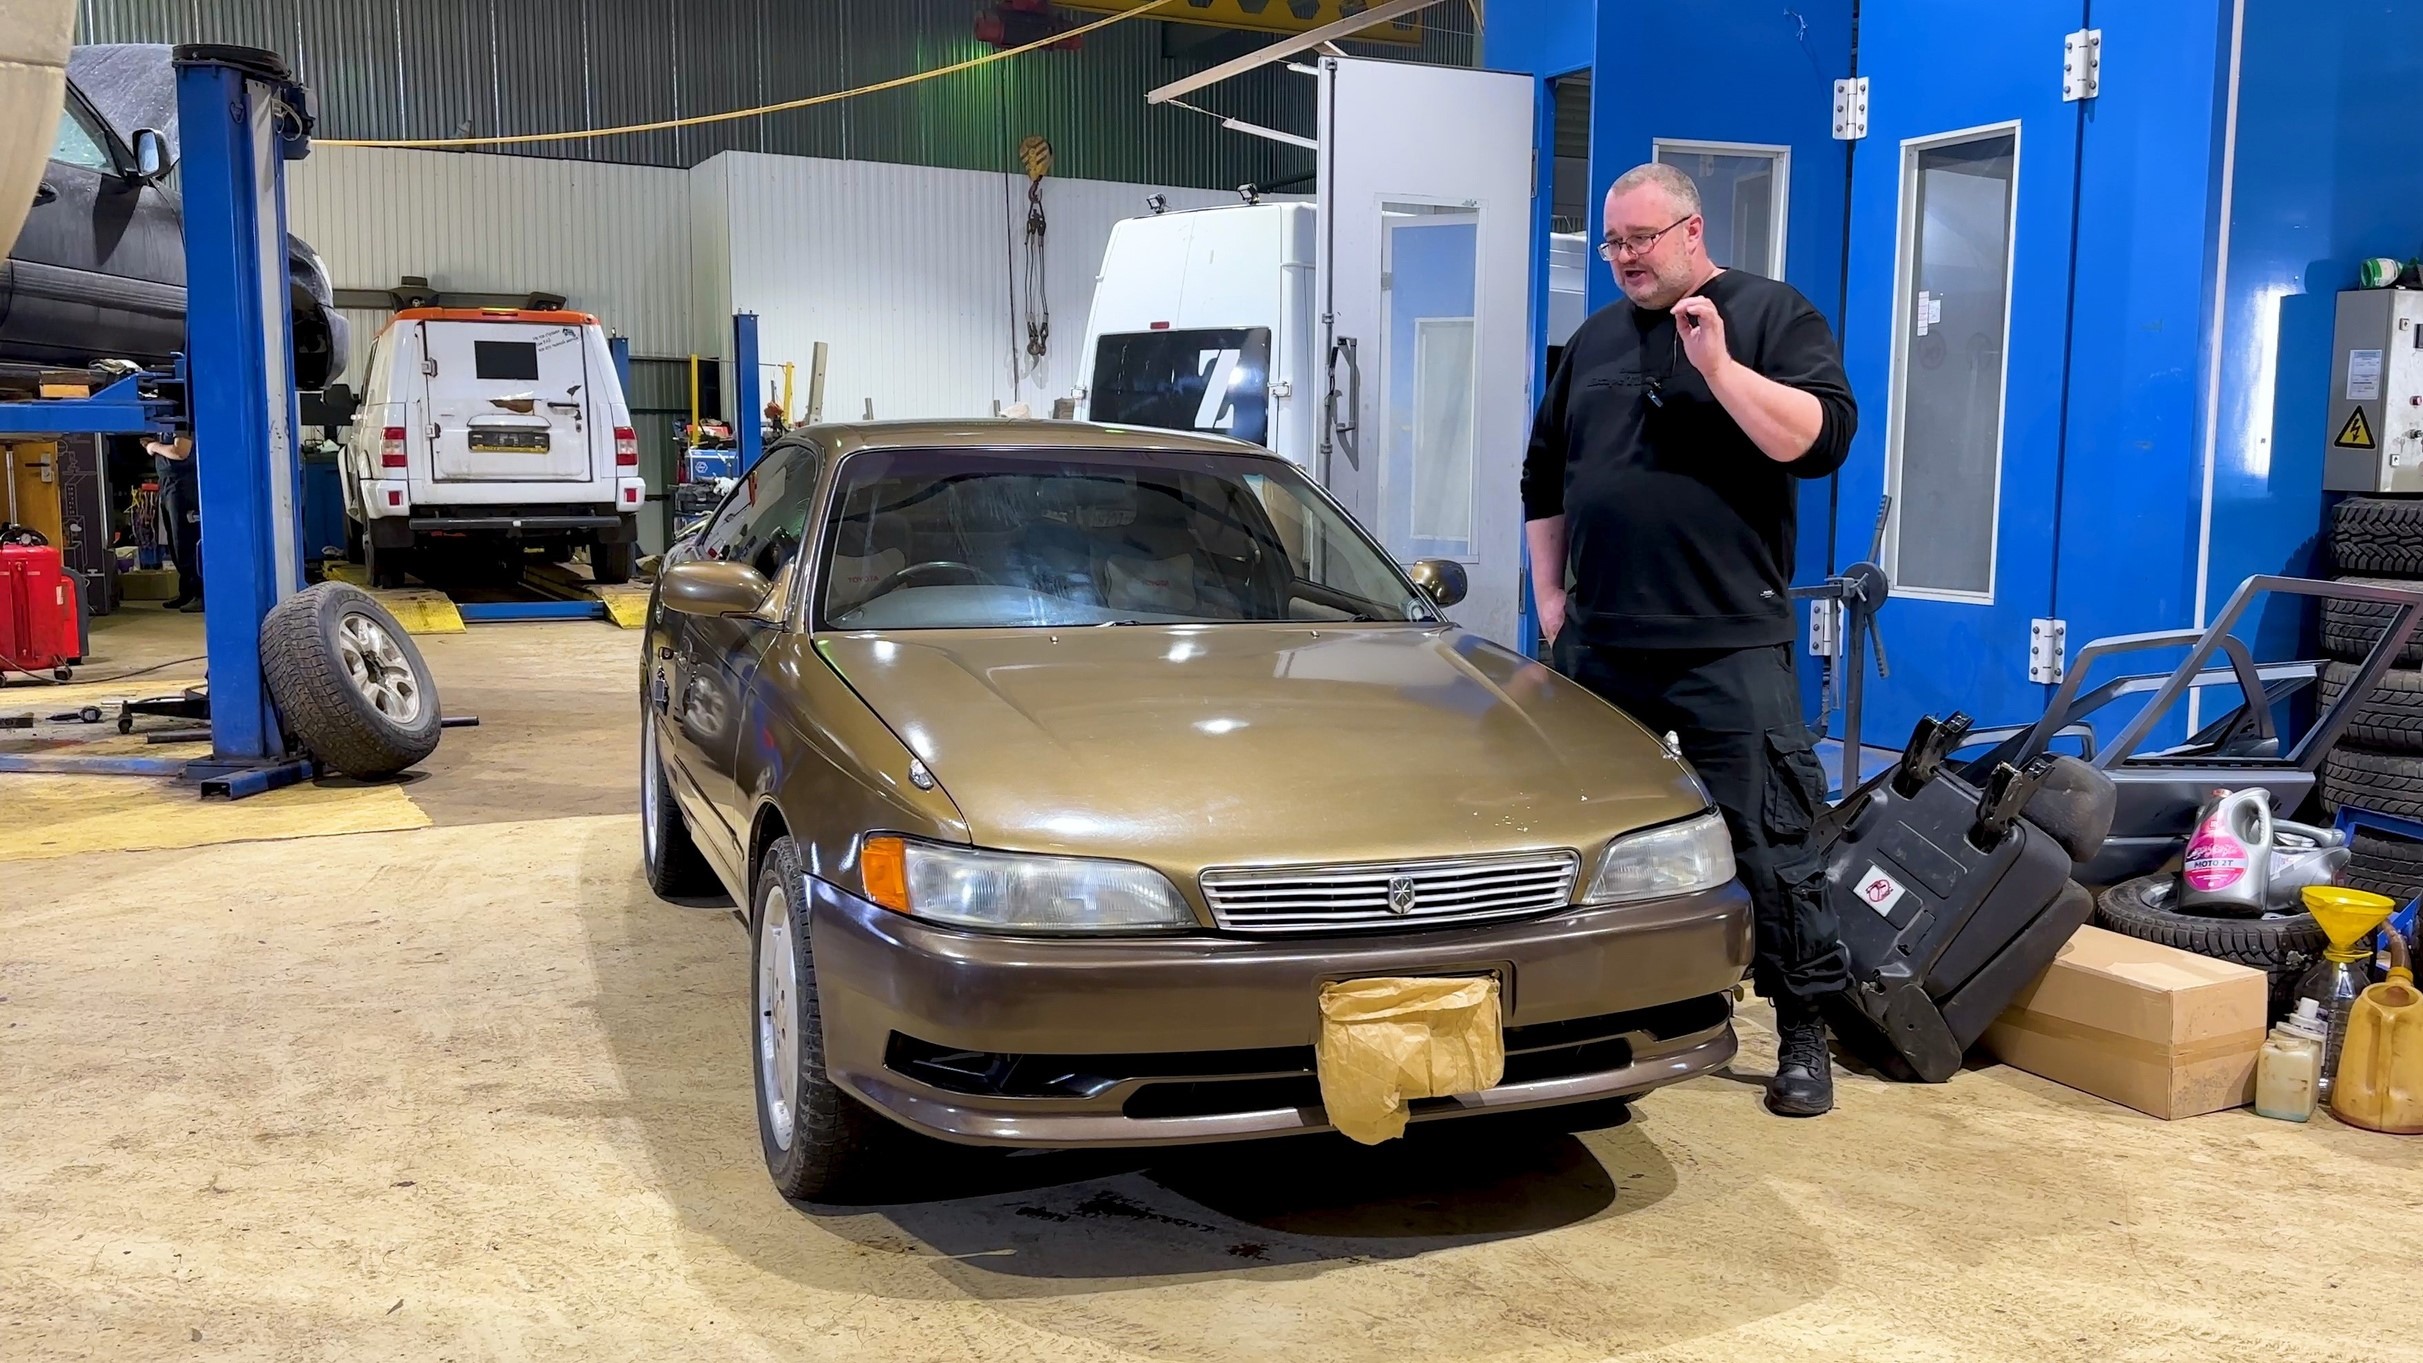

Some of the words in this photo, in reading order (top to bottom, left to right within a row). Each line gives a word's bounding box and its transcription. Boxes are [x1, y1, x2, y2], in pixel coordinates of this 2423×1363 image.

[1194, 349, 1241, 429] Z
[847, 575, 881, 584] TOYOTA
[2194, 859, 2219, 869] MOTO
